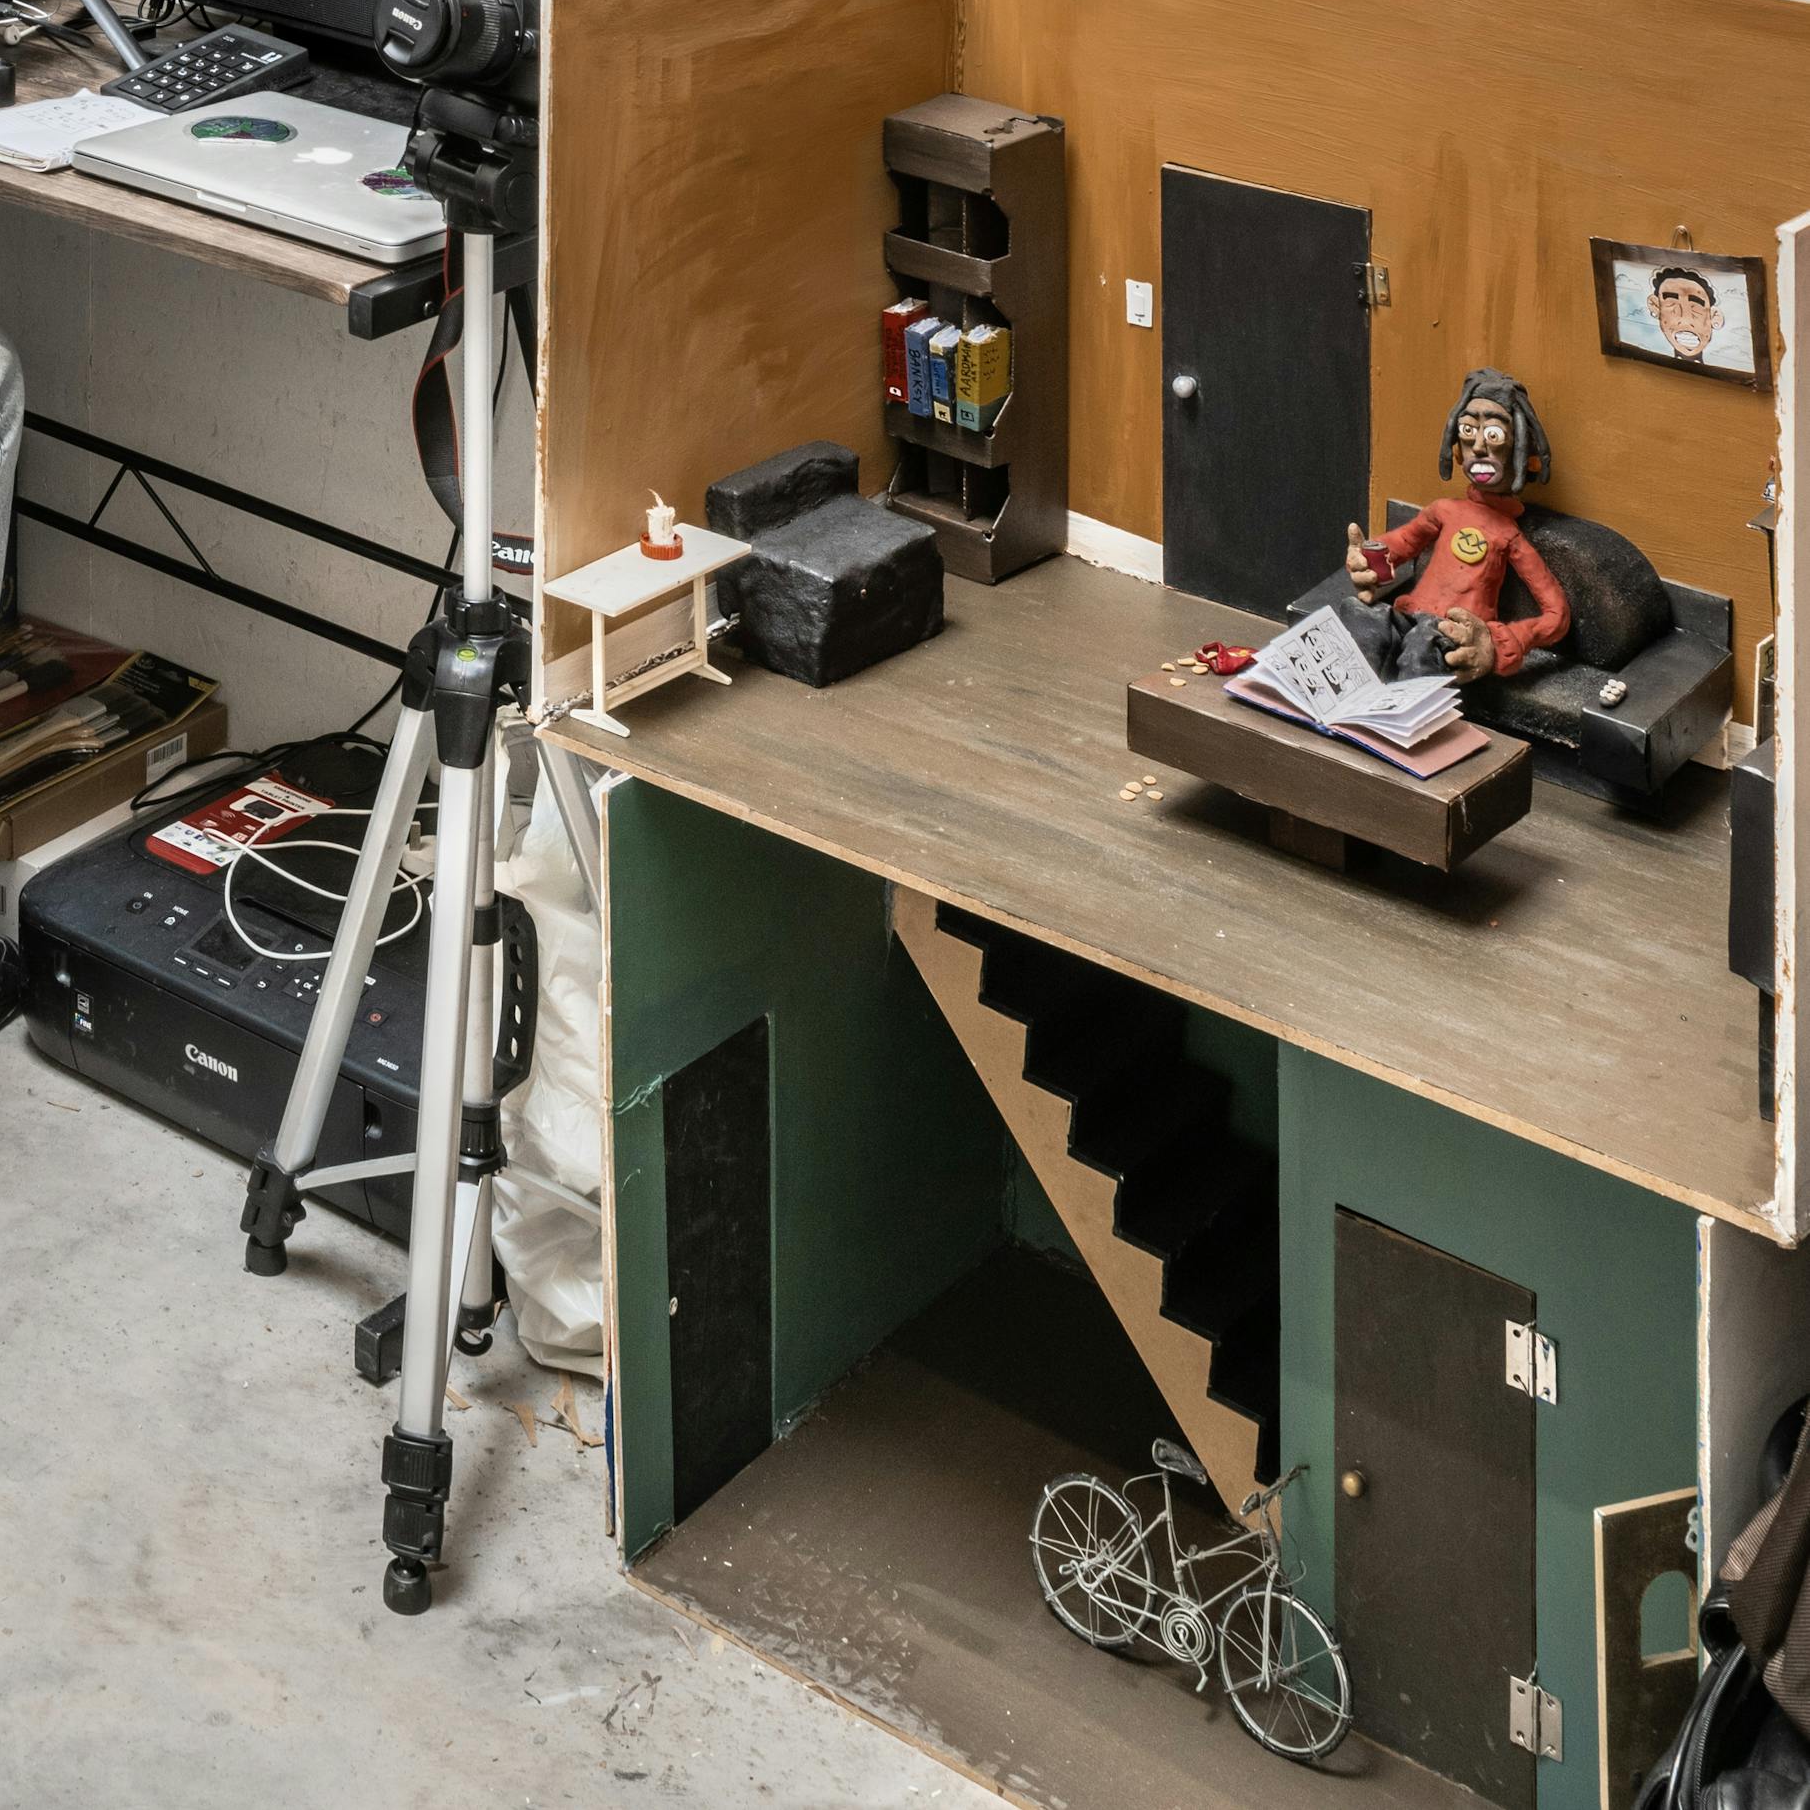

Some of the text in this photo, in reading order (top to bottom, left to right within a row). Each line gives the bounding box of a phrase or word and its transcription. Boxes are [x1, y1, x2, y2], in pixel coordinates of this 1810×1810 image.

[392, 6, 423, 32] Canon
[908, 348, 924, 405] BANKSY
[958, 341, 974, 398] AARDMAN
[143, 890, 153, 900] ON
[172, 904, 189, 916] HOME
[184, 1042, 239, 1084] Canon
